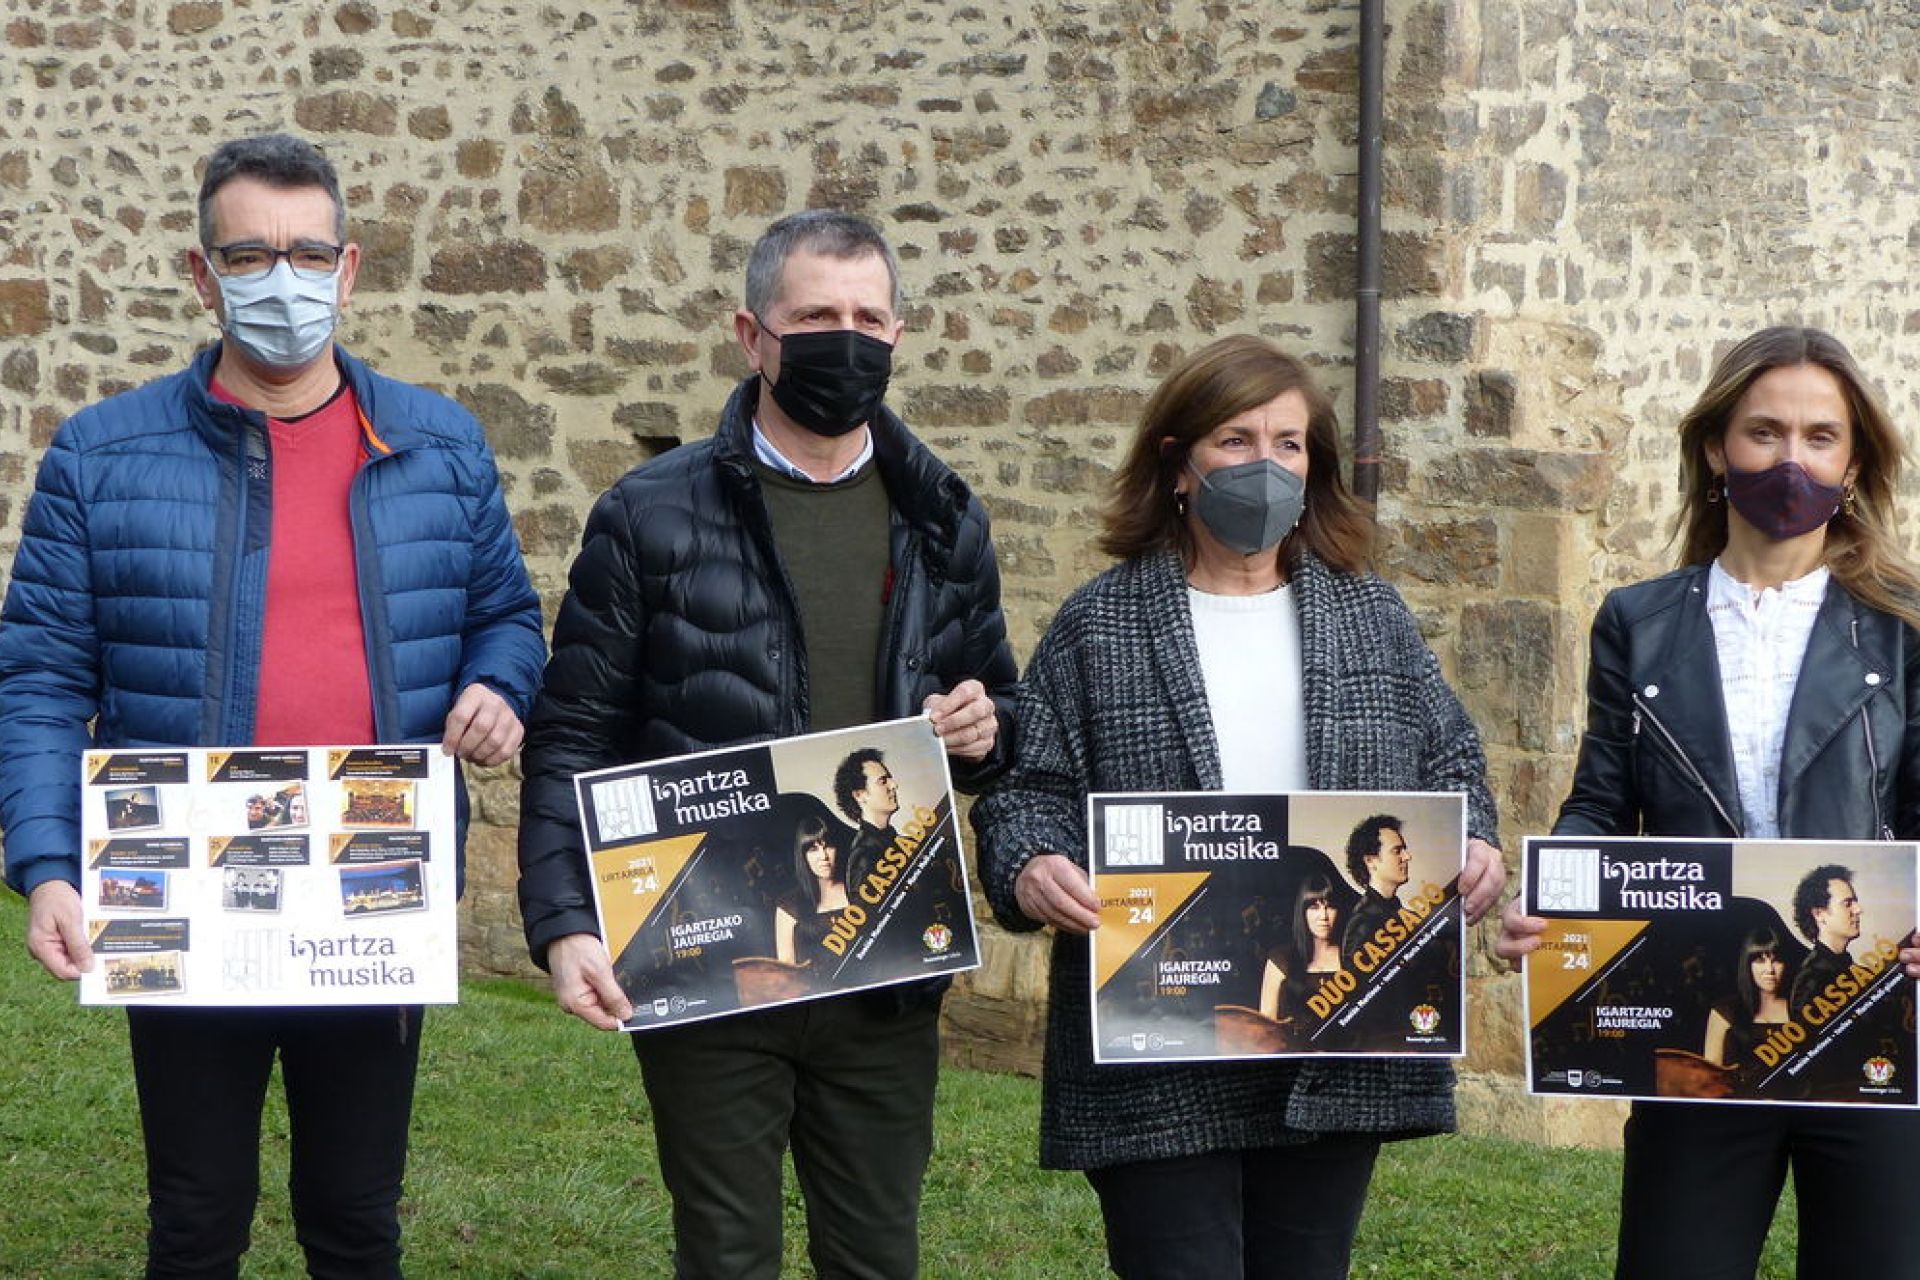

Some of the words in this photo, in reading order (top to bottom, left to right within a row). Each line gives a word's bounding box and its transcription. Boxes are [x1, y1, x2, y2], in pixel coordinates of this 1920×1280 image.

[674, 791, 771, 825] musika
[1166, 810, 1262, 843] igartza
[1184, 836, 1280, 861] musika
[822, 905, 867, 956] DÚO
[859, 804, 937, 904] CASSADÓ
[1602, 855, 1705, 889] igartza
[631, 876, 657, 895] 24
[1620, 886, 1722, 910] musika
[671, 914, 743, 937] IGARTZAKO
[1128, 907, 1152, 924] 24
[673, 928, 734, 949] JAUREGIA
[1306, 969, 1357, 1019] DÚO
[1353, 880, 1445, 973] CASSADÓ
[1159, 960, 1231, 973] IGARTZAKO
[1563, 953, 1588, 970] 24
[309, 961, 415, 987] musika
[1159, 972, 1220, 986] JAUREGIA
[1596, 1005, 1673, 1018] IGARTZAKO
[1597, 1017, 1662, 1030] JAUREGIA
[1753, 1021, 1806, 1067] DÚO
